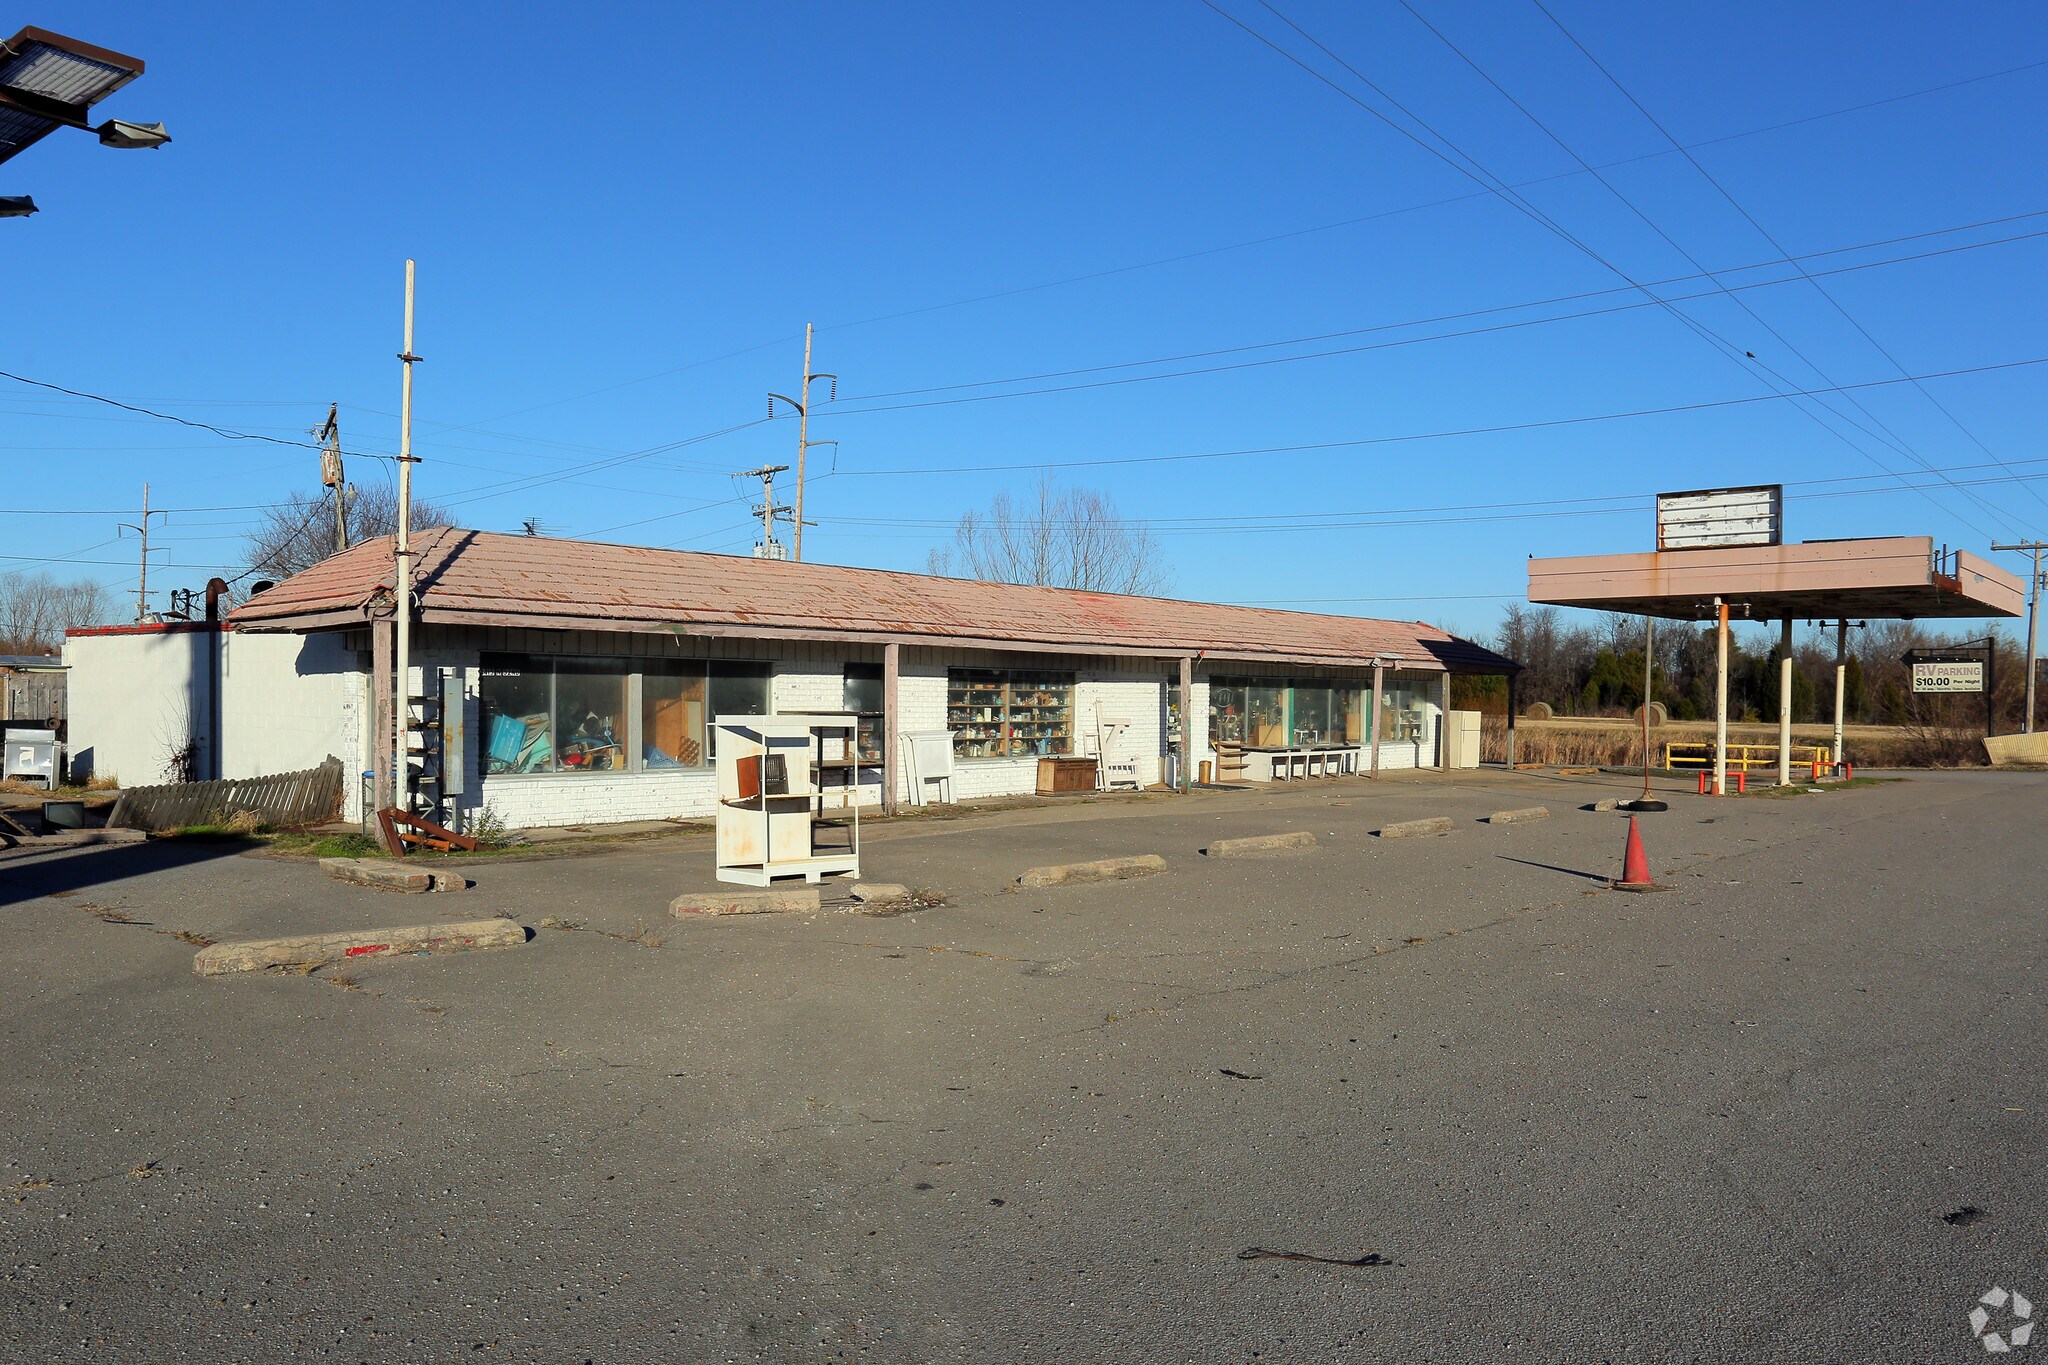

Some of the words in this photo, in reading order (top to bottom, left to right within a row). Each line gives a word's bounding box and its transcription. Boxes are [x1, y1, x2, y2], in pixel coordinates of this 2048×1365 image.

[1915, 665, 1936, 676] RV
[1938, 667, 1980, 676] PARKING
[1916, 677, 1950, 686] $10.00
